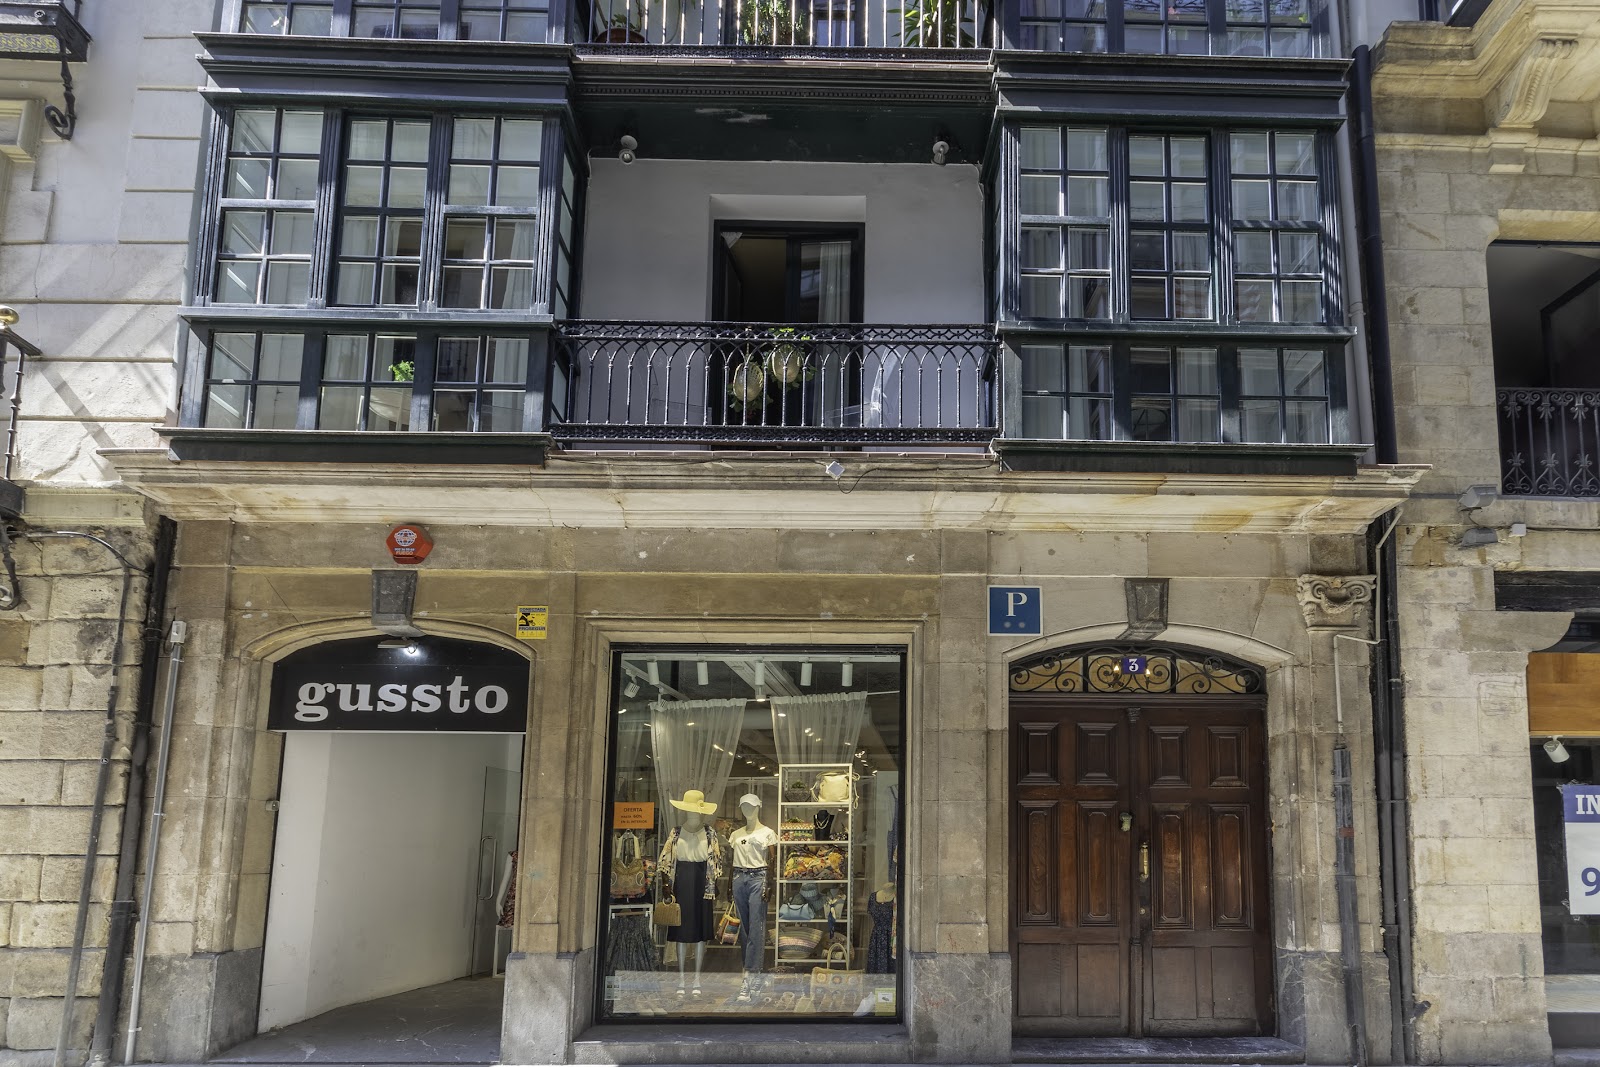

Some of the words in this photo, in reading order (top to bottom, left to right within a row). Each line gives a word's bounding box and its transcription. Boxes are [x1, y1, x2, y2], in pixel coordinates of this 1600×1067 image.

[1005, 591, 1028, 617] P
[1128, 658, 1139, 672] 3
[294, 675, 509, 722] gussto
